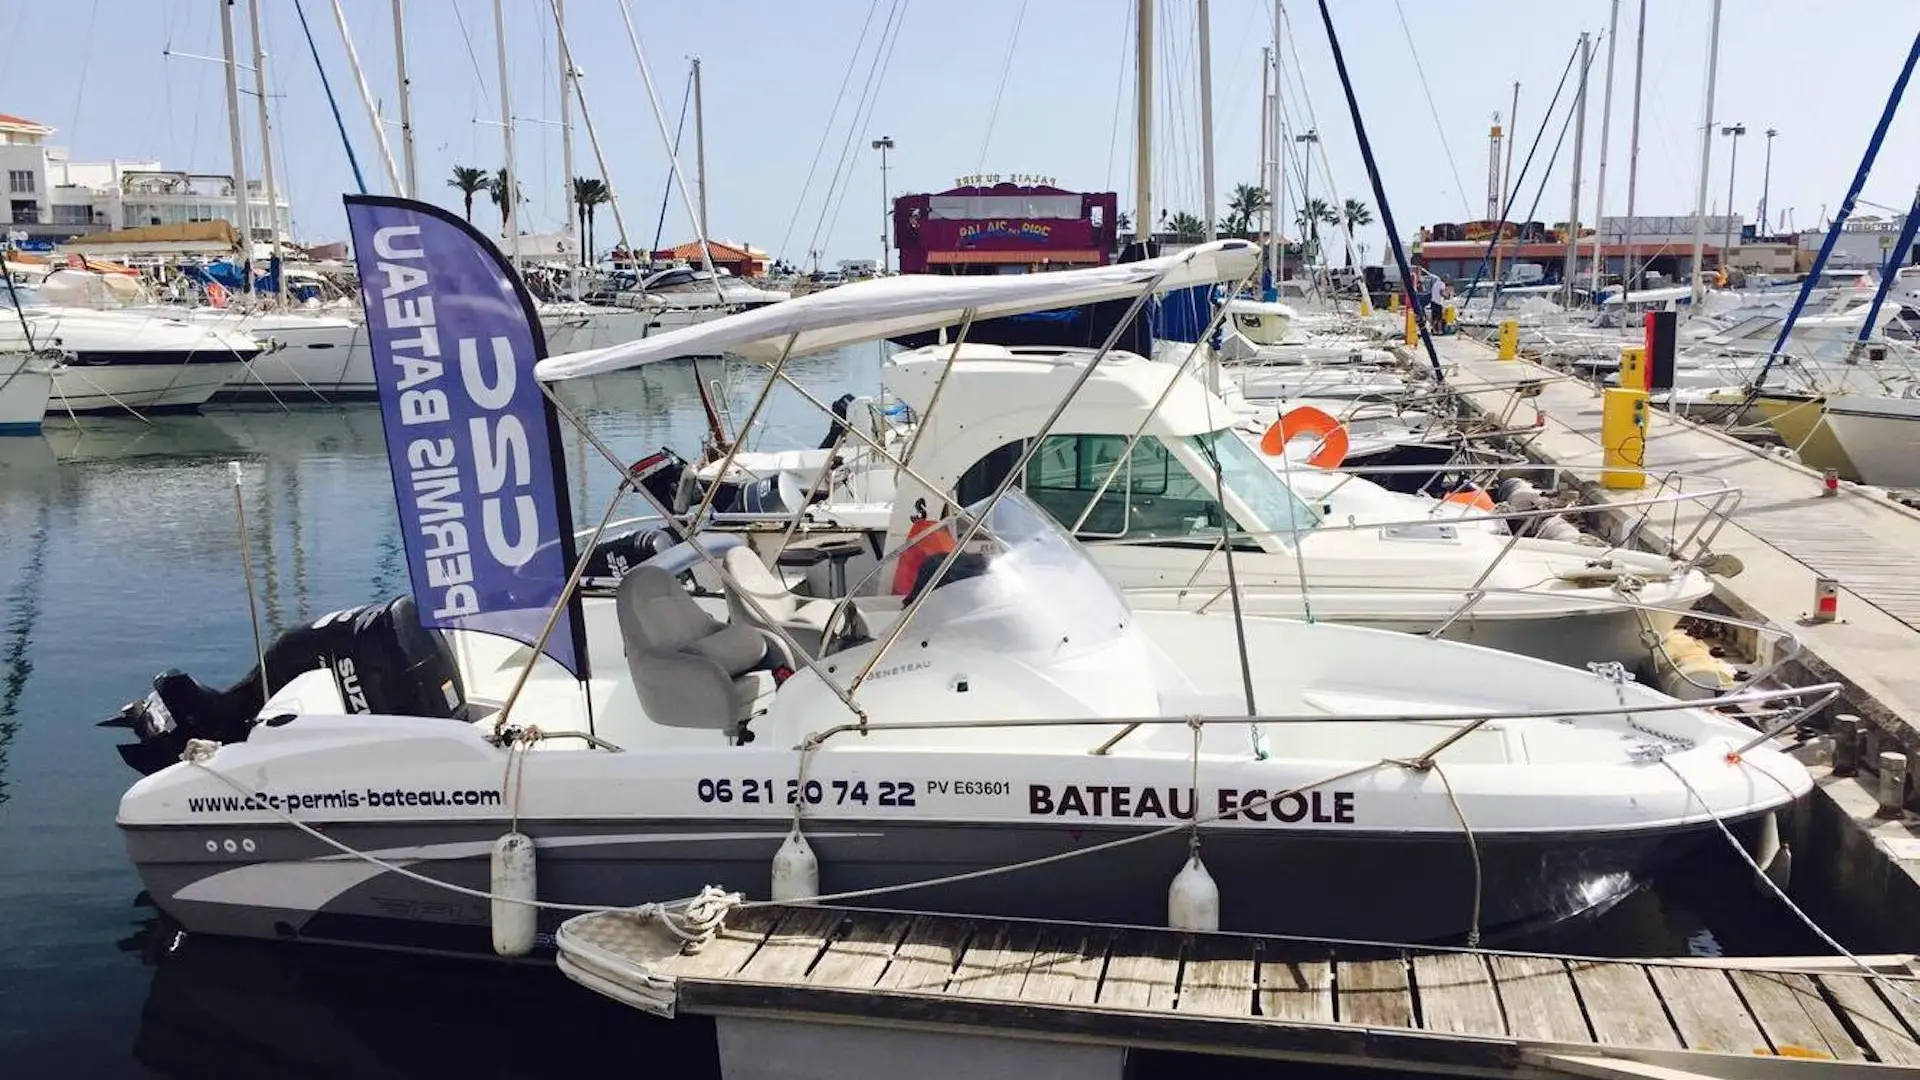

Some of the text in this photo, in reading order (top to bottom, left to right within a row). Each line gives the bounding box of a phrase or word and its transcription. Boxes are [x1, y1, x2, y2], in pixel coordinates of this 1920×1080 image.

[338, 657, 372, 714] SUZ
[188, 788, 501, 814] www.c2c-permis-bateau.com
[697, 779, 916, 806] 06 21 20 74 22
[927, 781, 1011, 796] PV E63601
[1029, 784, 1355, 824] BATEAU ECOLE
